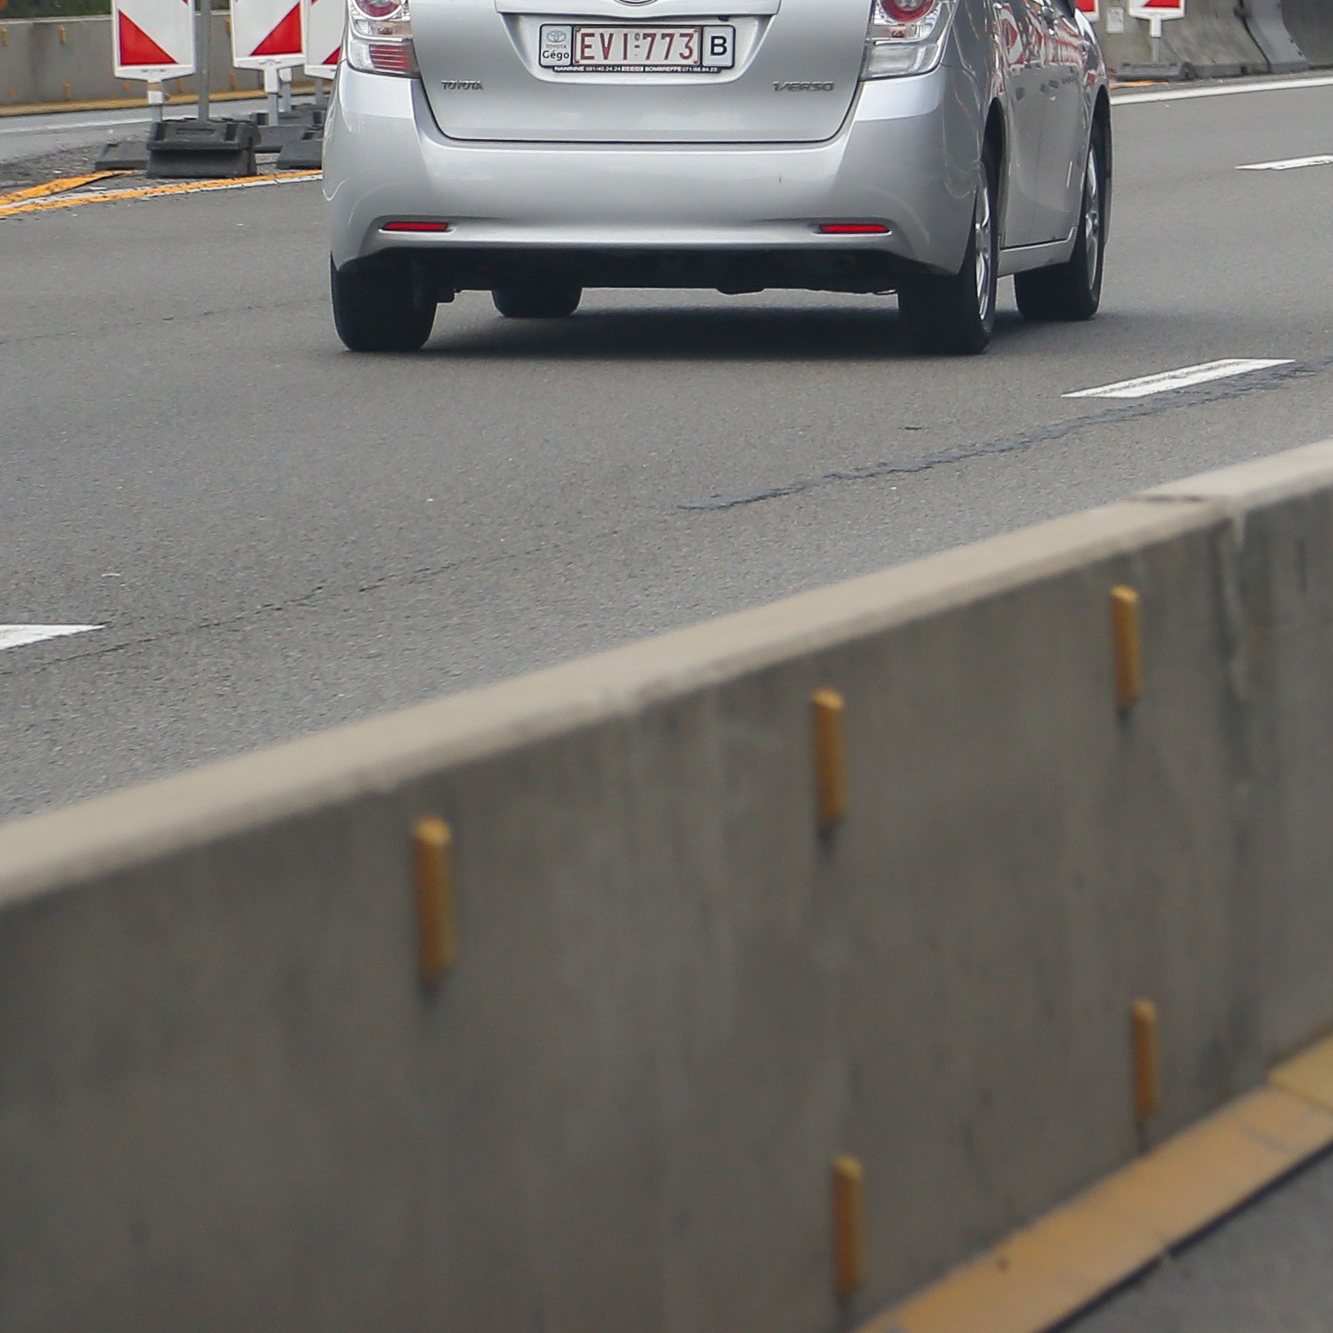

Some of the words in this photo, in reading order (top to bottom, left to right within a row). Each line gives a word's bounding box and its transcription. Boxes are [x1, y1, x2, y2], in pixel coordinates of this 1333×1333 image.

[710, 35, 728, 56] B
[542, 50, 570, 61] Gégo
[441, 80, 484, 90] TOYOTA
[772, 81, 834, 92] VERSO
